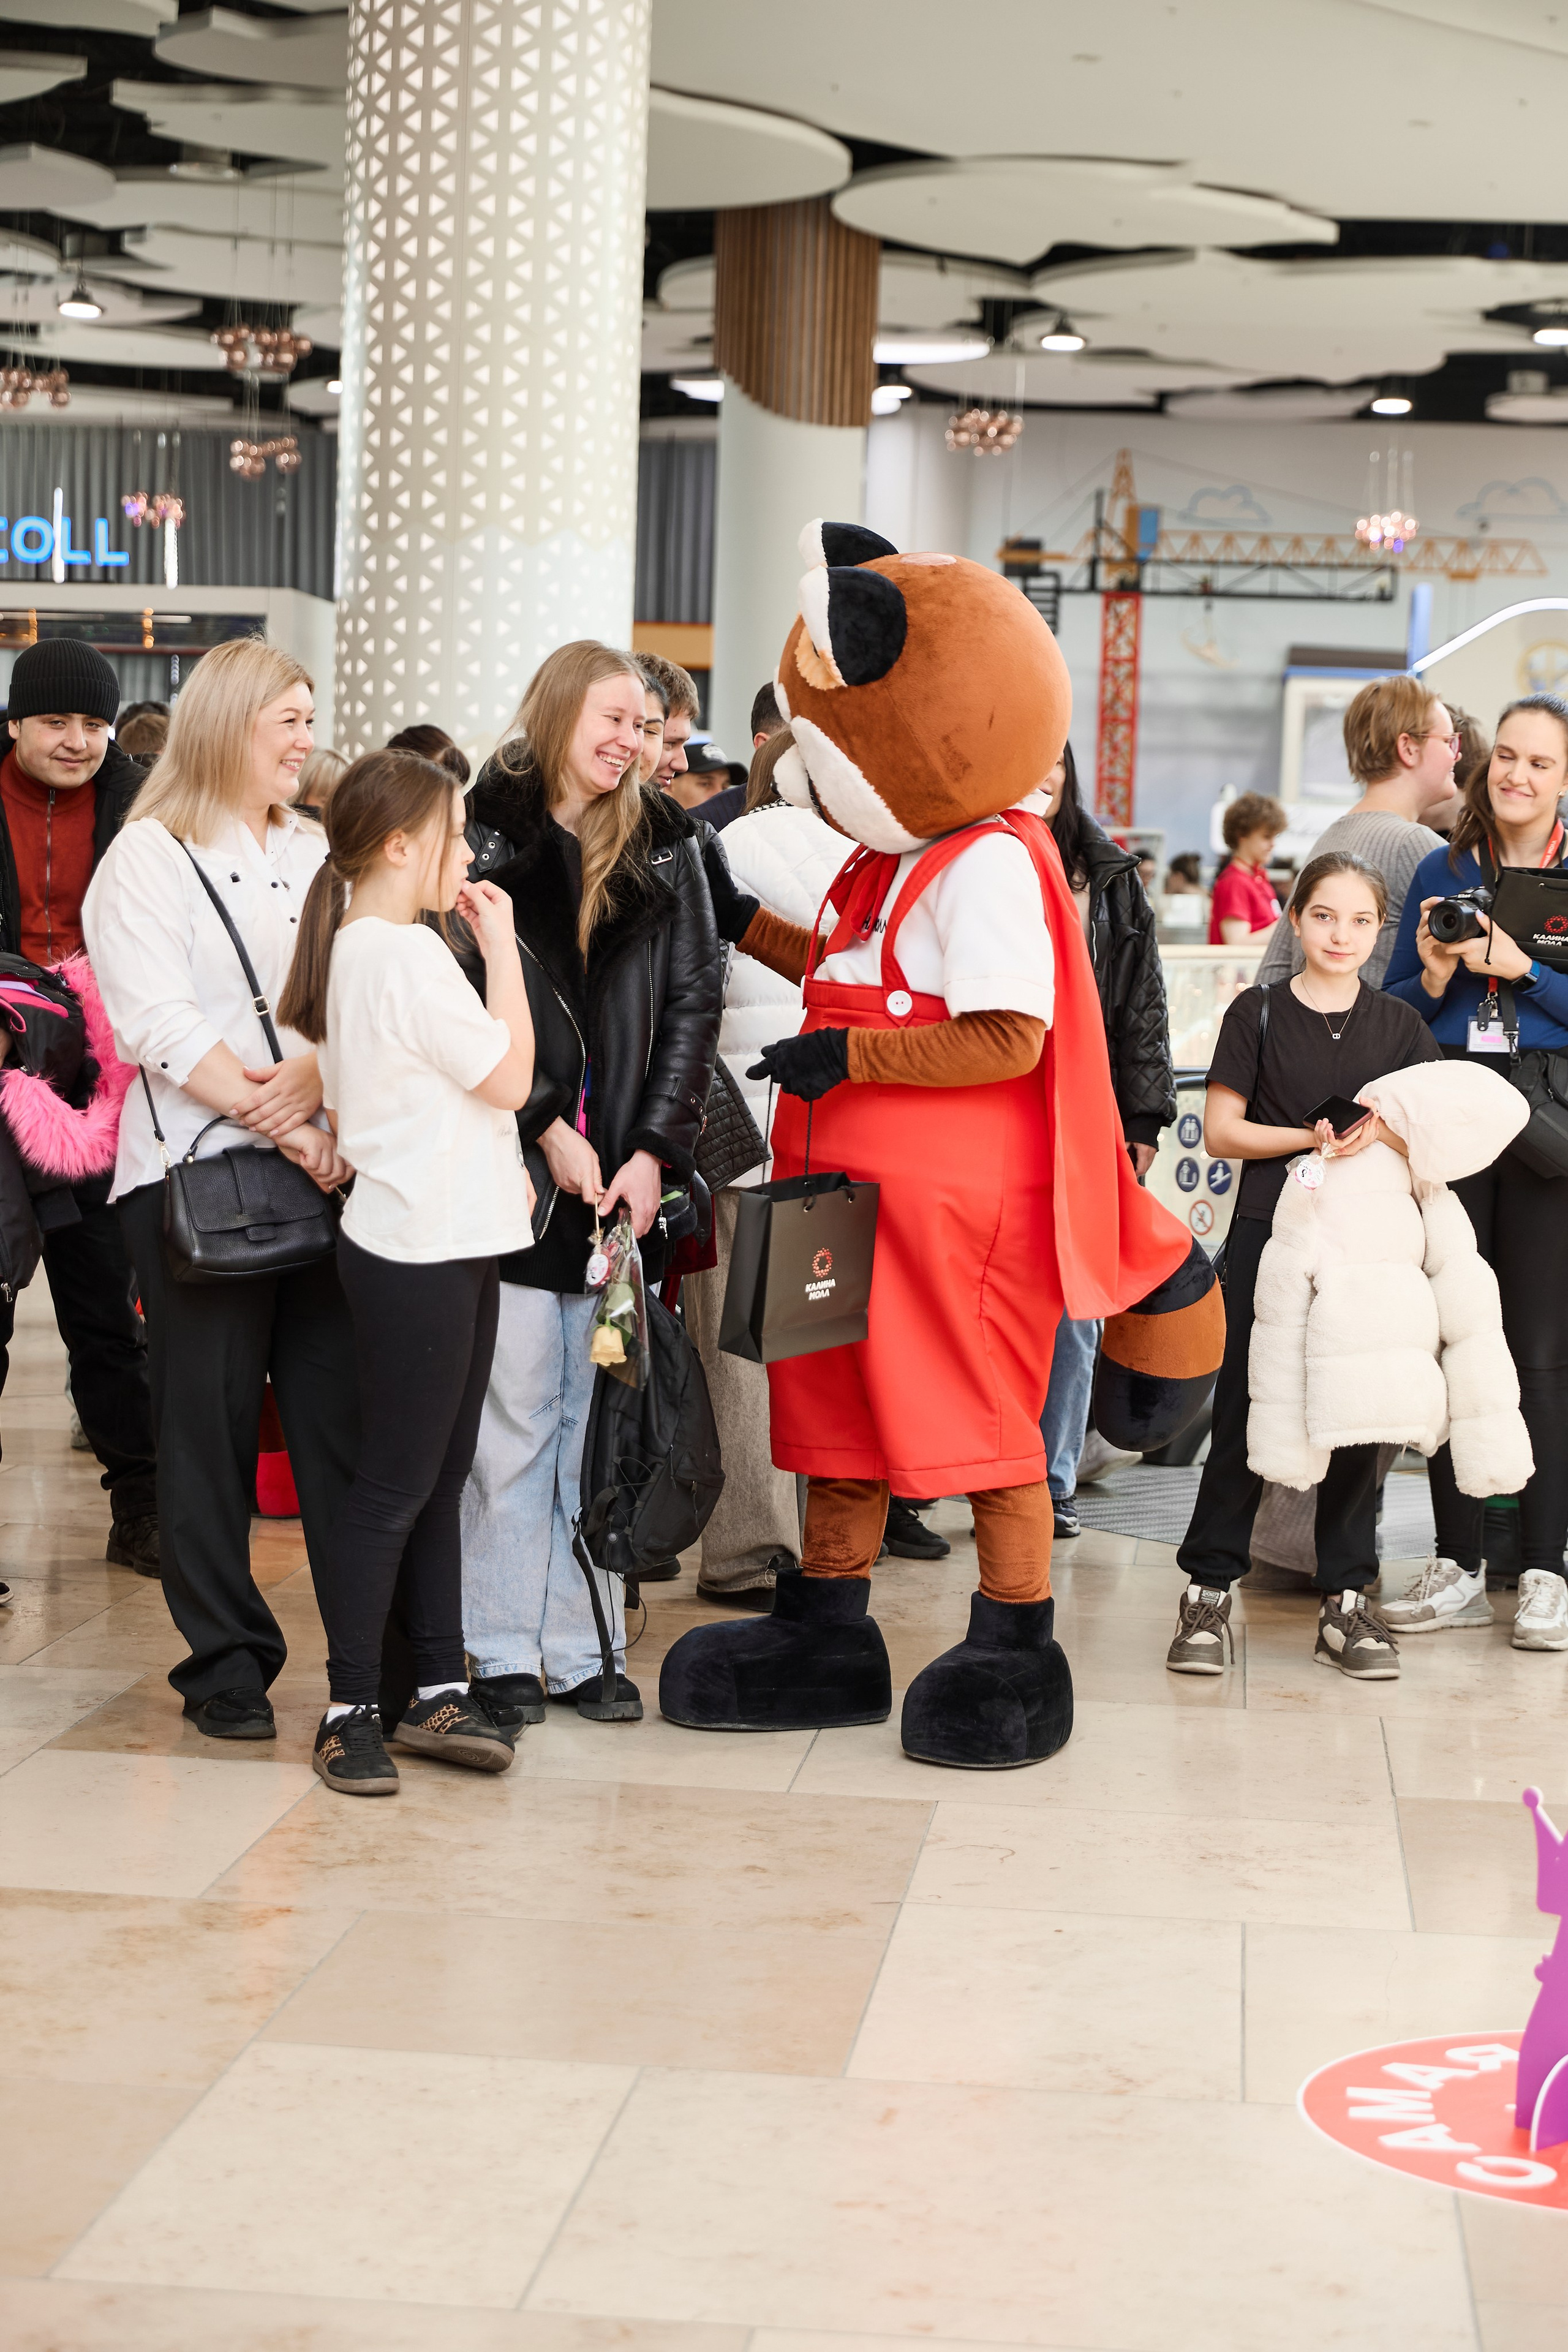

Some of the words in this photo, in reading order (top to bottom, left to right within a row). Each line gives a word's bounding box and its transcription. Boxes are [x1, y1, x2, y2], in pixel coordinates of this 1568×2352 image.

[0, 516, 130, 567] OLL
[805, 1278, 836, 1292] КАЛИНА
[809, 1288, 830, 1300] МОЛЛ
[1346, 2043, 1558, 2188] САМАЯ
